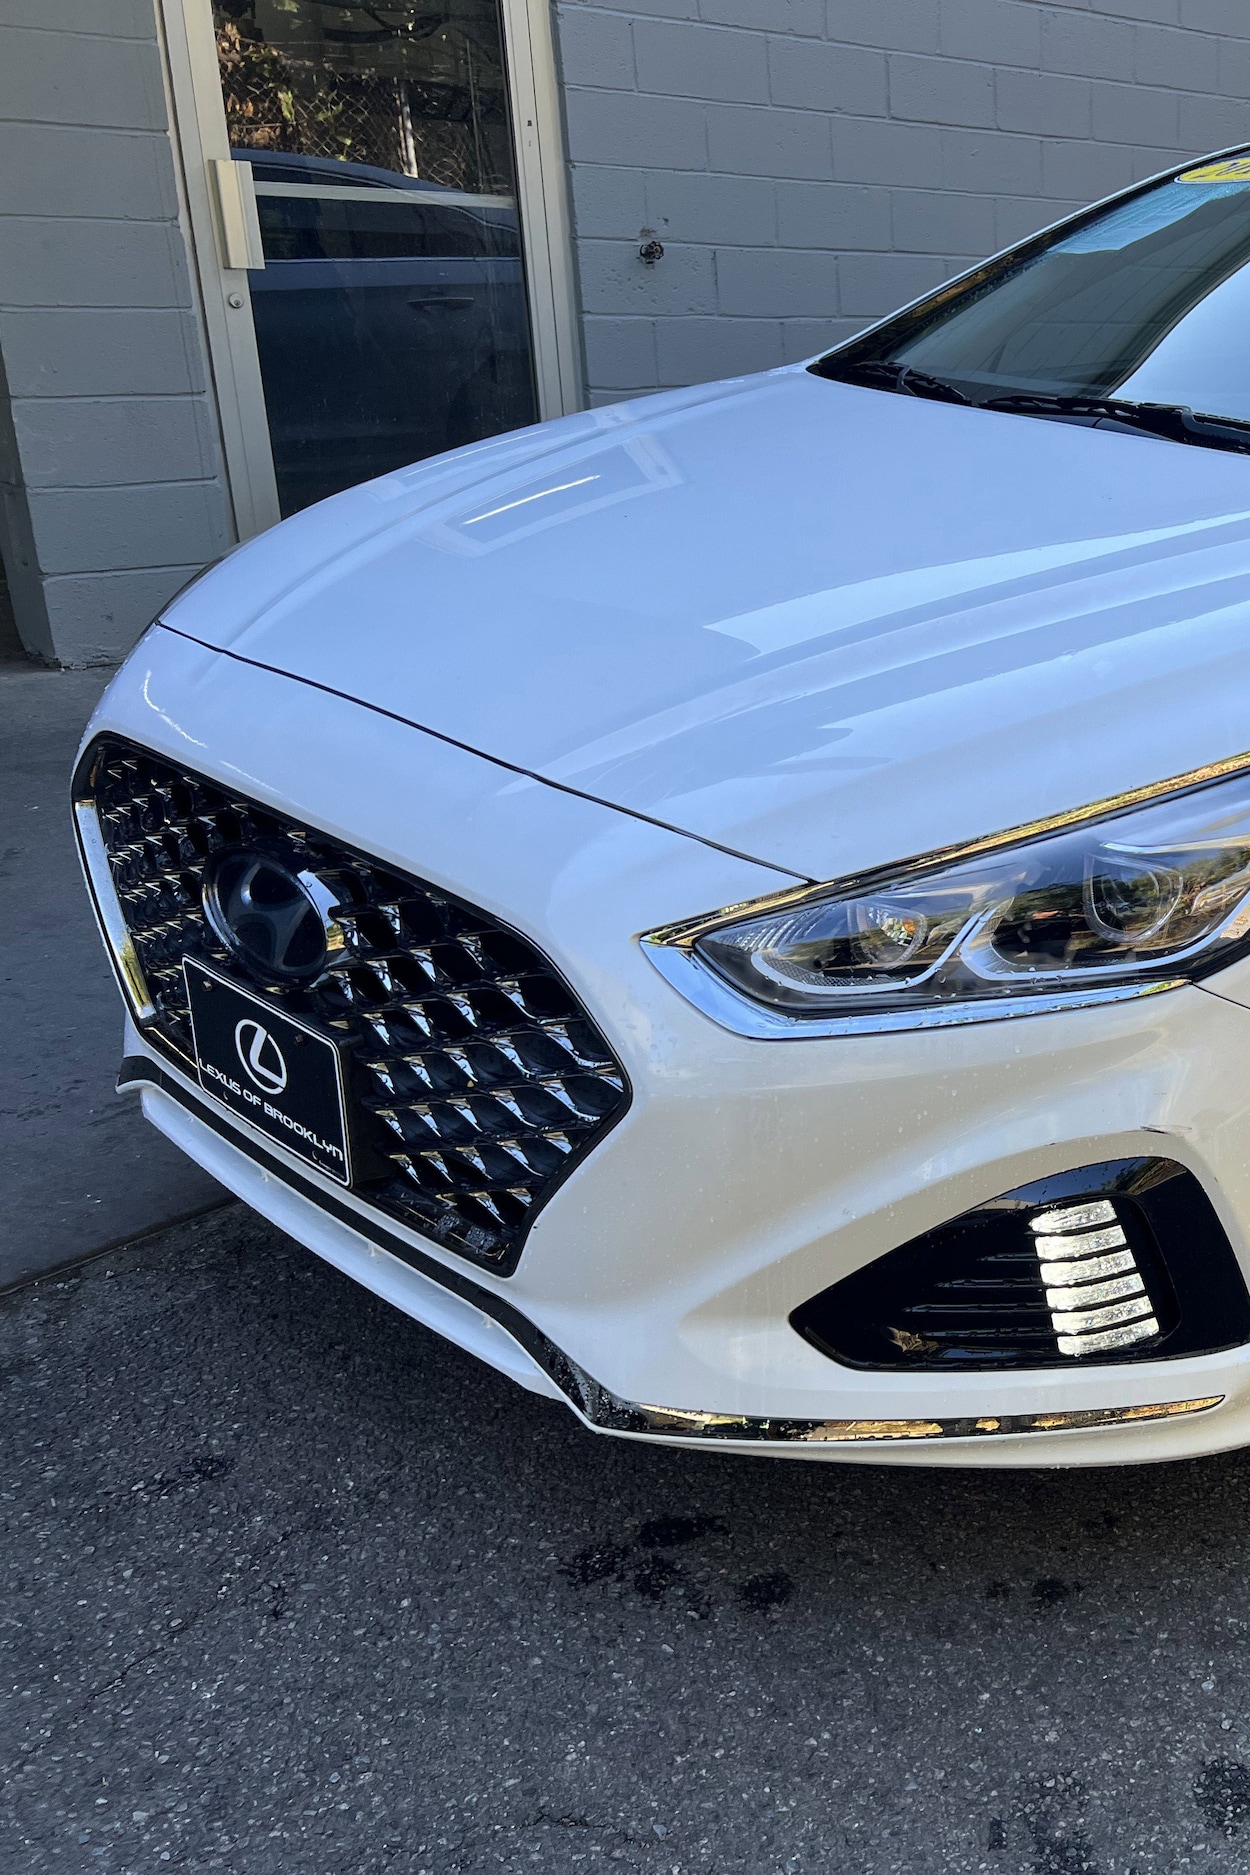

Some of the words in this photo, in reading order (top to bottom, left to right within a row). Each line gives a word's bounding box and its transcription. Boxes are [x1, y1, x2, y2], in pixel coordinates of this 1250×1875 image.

[199, 1058, 241, 1095] LEXUS
[243, 1089, 261, 1106] OF
[264, 1102, 343, 1161] BROOKLYN
